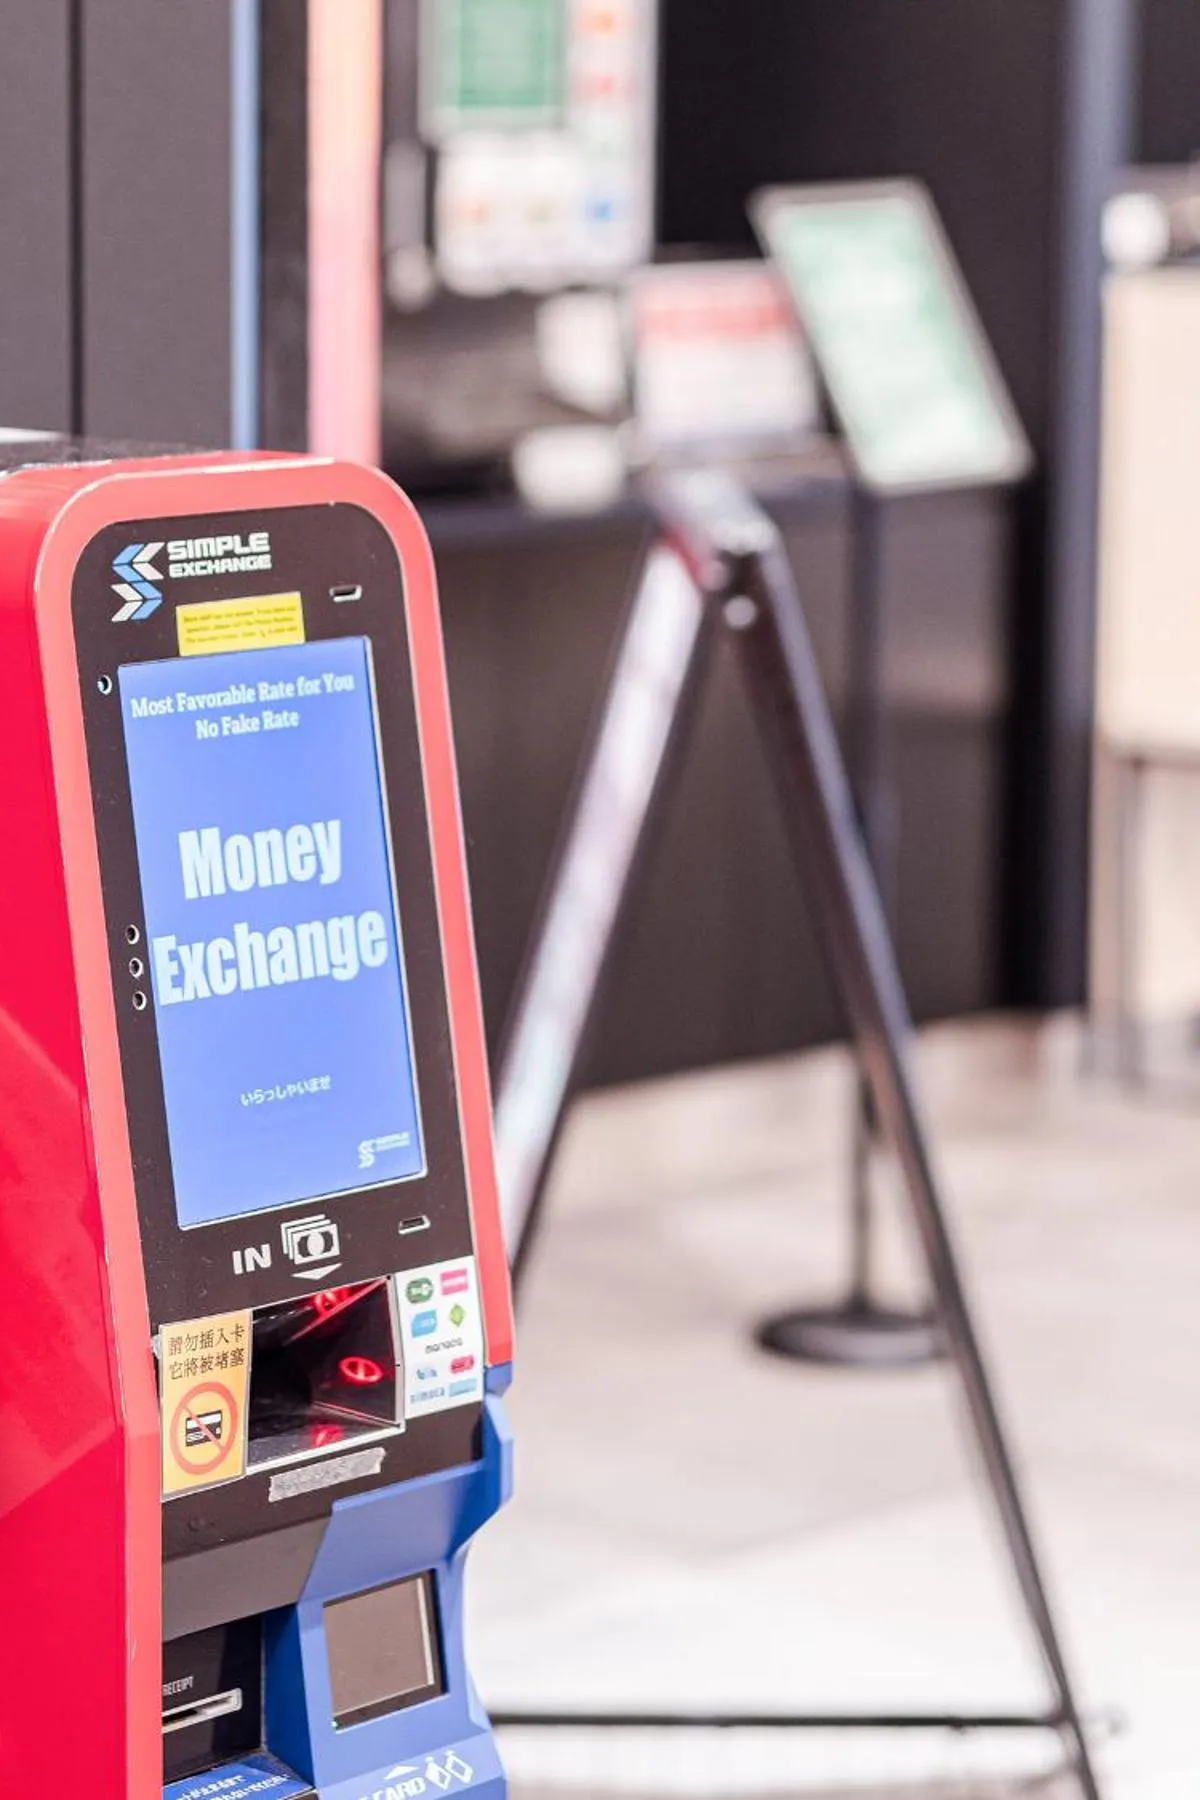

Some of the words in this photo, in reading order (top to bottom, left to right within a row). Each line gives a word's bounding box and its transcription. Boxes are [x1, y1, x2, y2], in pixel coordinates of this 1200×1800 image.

[167, 532, 270, 560] SIMPLE
[169, 554, 272, 578] EXCHANGE
[131, 695, 174, 718] Most
[176, 683, 256, 712] Favorable
[258, 678, 294, 701] Rate
[297, 676, 321, 697] for
[322, 673, 354, 692] You
[196, 719, 218, 740] No
[222, 713, 260, 736] Fake
[263, 710, 299, 730] Rate
[178, 819, 341, 899] Money
[152, 909, 388, 1006] Exchange
[241, 1075, 332, 1107] いらっしゃいませ
[232, 1244, 271, 1275] IN
[168, 1323, 245, 1356] 請勿插入卡
[163, 1676, 194, 1696] RECEIPT
